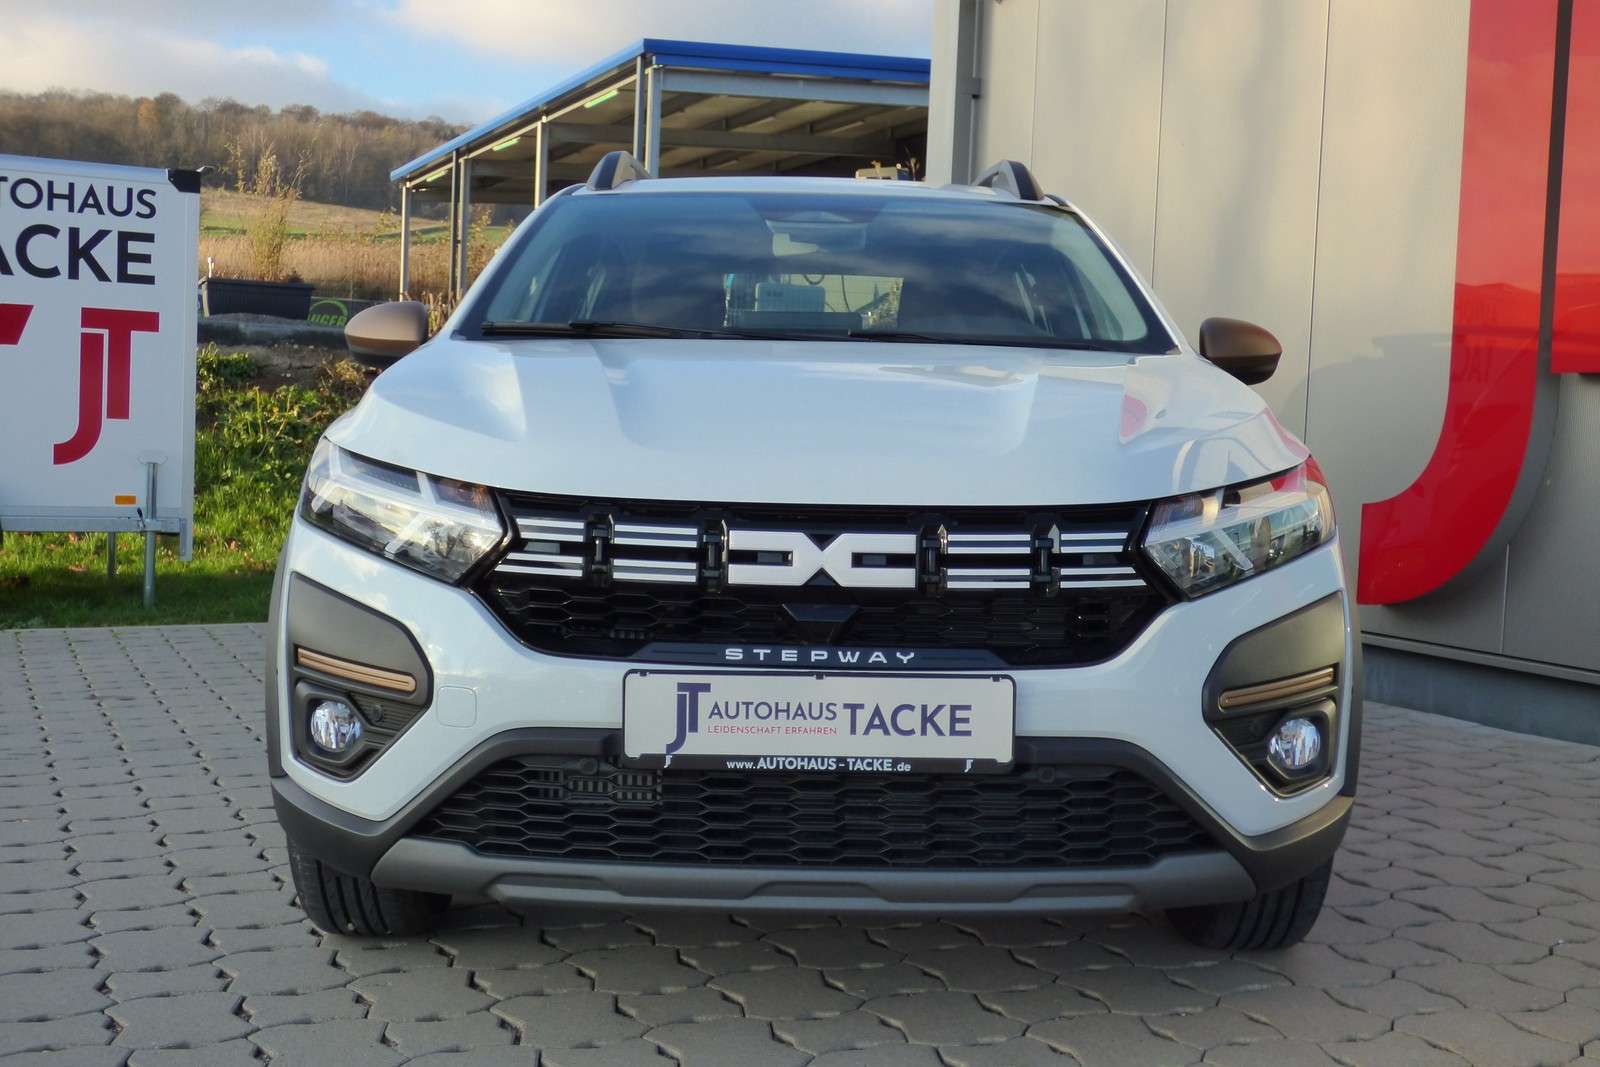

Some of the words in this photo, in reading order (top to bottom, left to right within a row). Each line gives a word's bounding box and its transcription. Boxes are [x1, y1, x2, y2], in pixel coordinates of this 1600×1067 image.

[53, 307, 160, 465] JT
[725, 647, 915, 664] STEPWAY
[666, 682, 711, 755] JT
[708, 701, 837, 721] AUTOHAUS
[843, 703, 972, 737] TACKE
[707, 725, 781, 735] LEIDENSCHAFT
[785, 726, 837, 736] ERFAHREN
